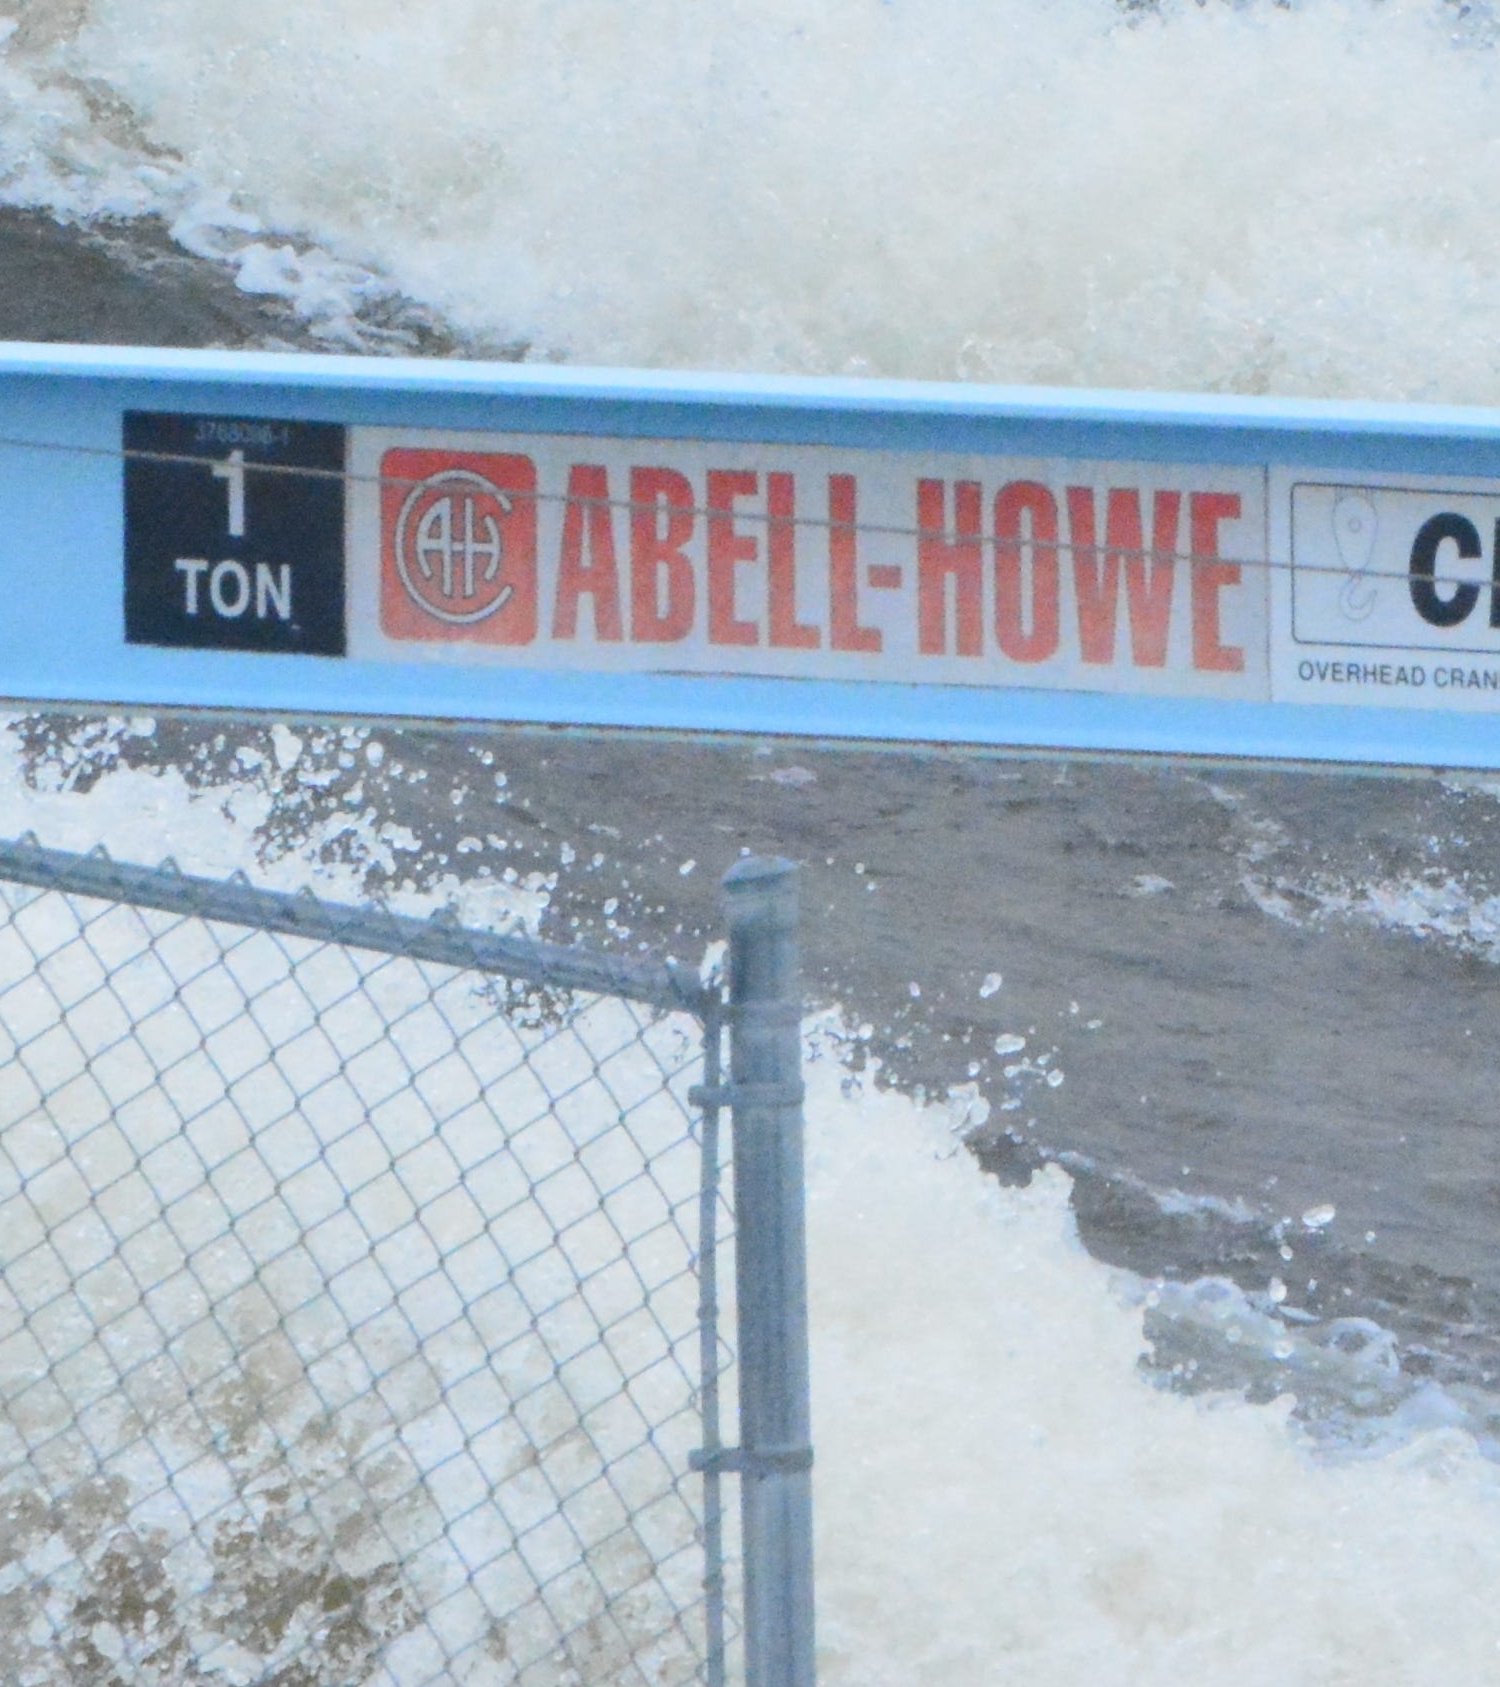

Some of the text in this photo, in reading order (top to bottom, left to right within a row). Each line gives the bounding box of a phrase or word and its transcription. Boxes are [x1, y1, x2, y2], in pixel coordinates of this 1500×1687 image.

[211, 449, 245, 536] 1
[174, 558, 291, 621] TON
[552, 464, 1245, 673] ABELL-HOWE
[1298, 660, 1426, 688] OVERHEAD
